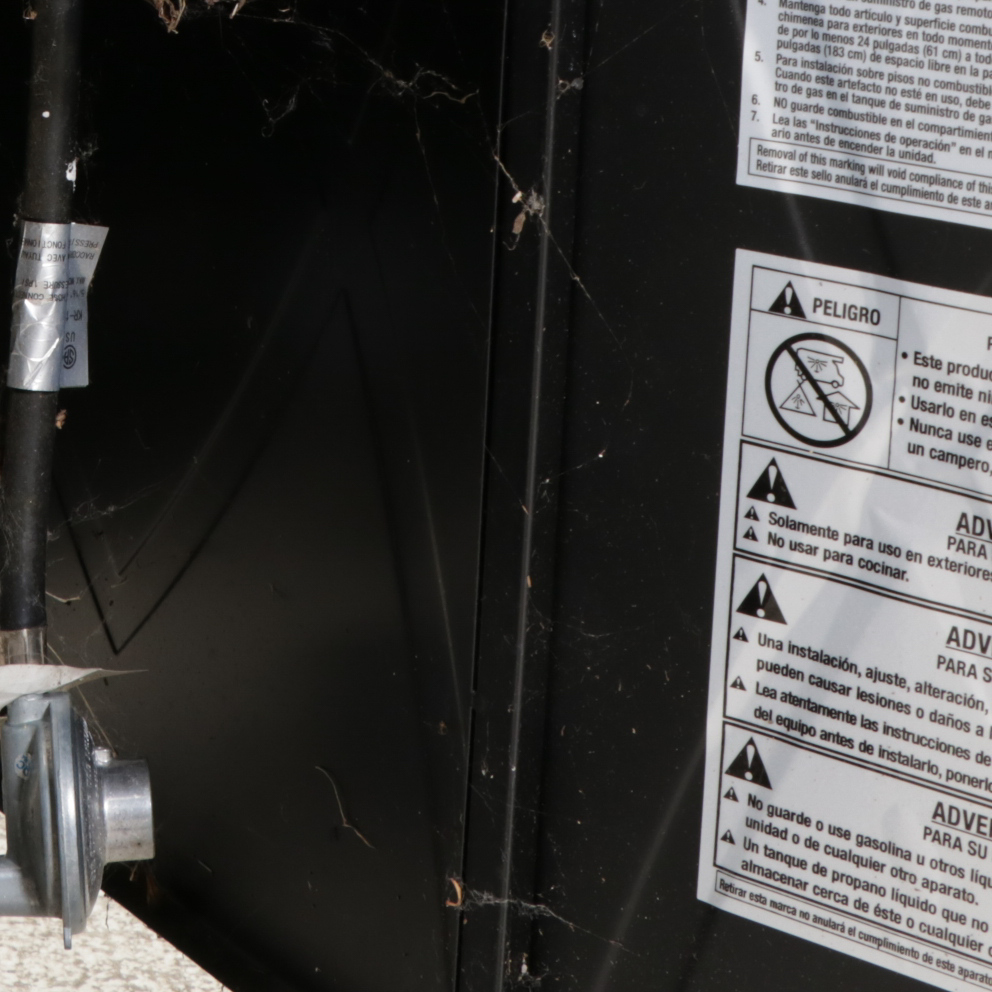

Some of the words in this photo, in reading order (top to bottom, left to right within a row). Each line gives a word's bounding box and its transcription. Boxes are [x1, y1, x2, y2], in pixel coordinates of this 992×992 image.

[757, 144, 796, 162] Removal
[798, 152, 807, 164] of
[809, 153, 826, 167] this
[828, 158, 866, 176] marking
[867, 163, 884, 176] will
[886, 167, 906, 180] void
[908, 171, 963, 189] compliance
[965, 179, 976, 192] of
[812, 298, 881, 326] PELIGRO
[913, 351, 943, 371] Este
[912, 376, 929, 391] no
[933, 381, 973, 400] emite
[910, 396, 954, 419] Usarlo
[958, 409, 976, 424] en
[907, 442, 924, 457] un
[909, 418, 952, 442] Nunca
[957, 432, 982, 448] use
[767, 531, 785, 549] No
[788, 539, 818, 558] usar
[822, 548, 853, 567] para
[857, 558, 909, 582] cocinar.
[768, 512, 838, 542] Solamente
[843, 534, 874, 551] para
[877, 542, 902, 559] uso
[904, 549, 922, 564] en
[758, 633, 783, 652] Una
[787, 642, 863, 677] instalación,
[865, 665, 908, 690] ajuste,
[914, 679, 989, 714] alteración,
[747, 793, 763, 811] No
[766, 802, 812, 827] guarde
[815, 818, 824, 831] o
[827, 822, 851, 840] use
[855, 832, 912, 861] gasolina
[916, 852, 925, 865] u
[929, 856, 965, 878] otros
[923, 826, 963, 851] PARA
[967, 839, 988, 858] SU
[745, 818, 788, 841] unidad
[791, 833, 800, 845] o
[803, 834, 820, 852] de
[823, 844, 885, 874] cualquier
[889, 865, 917, 885] otro
[921, 876, 978, 906] aparato.
[743, 837, 759, 855] Un
[762, 844, 807, 872] tanque
[811, 860, 827, 878] de
[830, 870, 886, 898] propano
[890, 886, 937, 915] líquido
[940, 906, 966, 925] que
[971, 916, 989, 933] no
